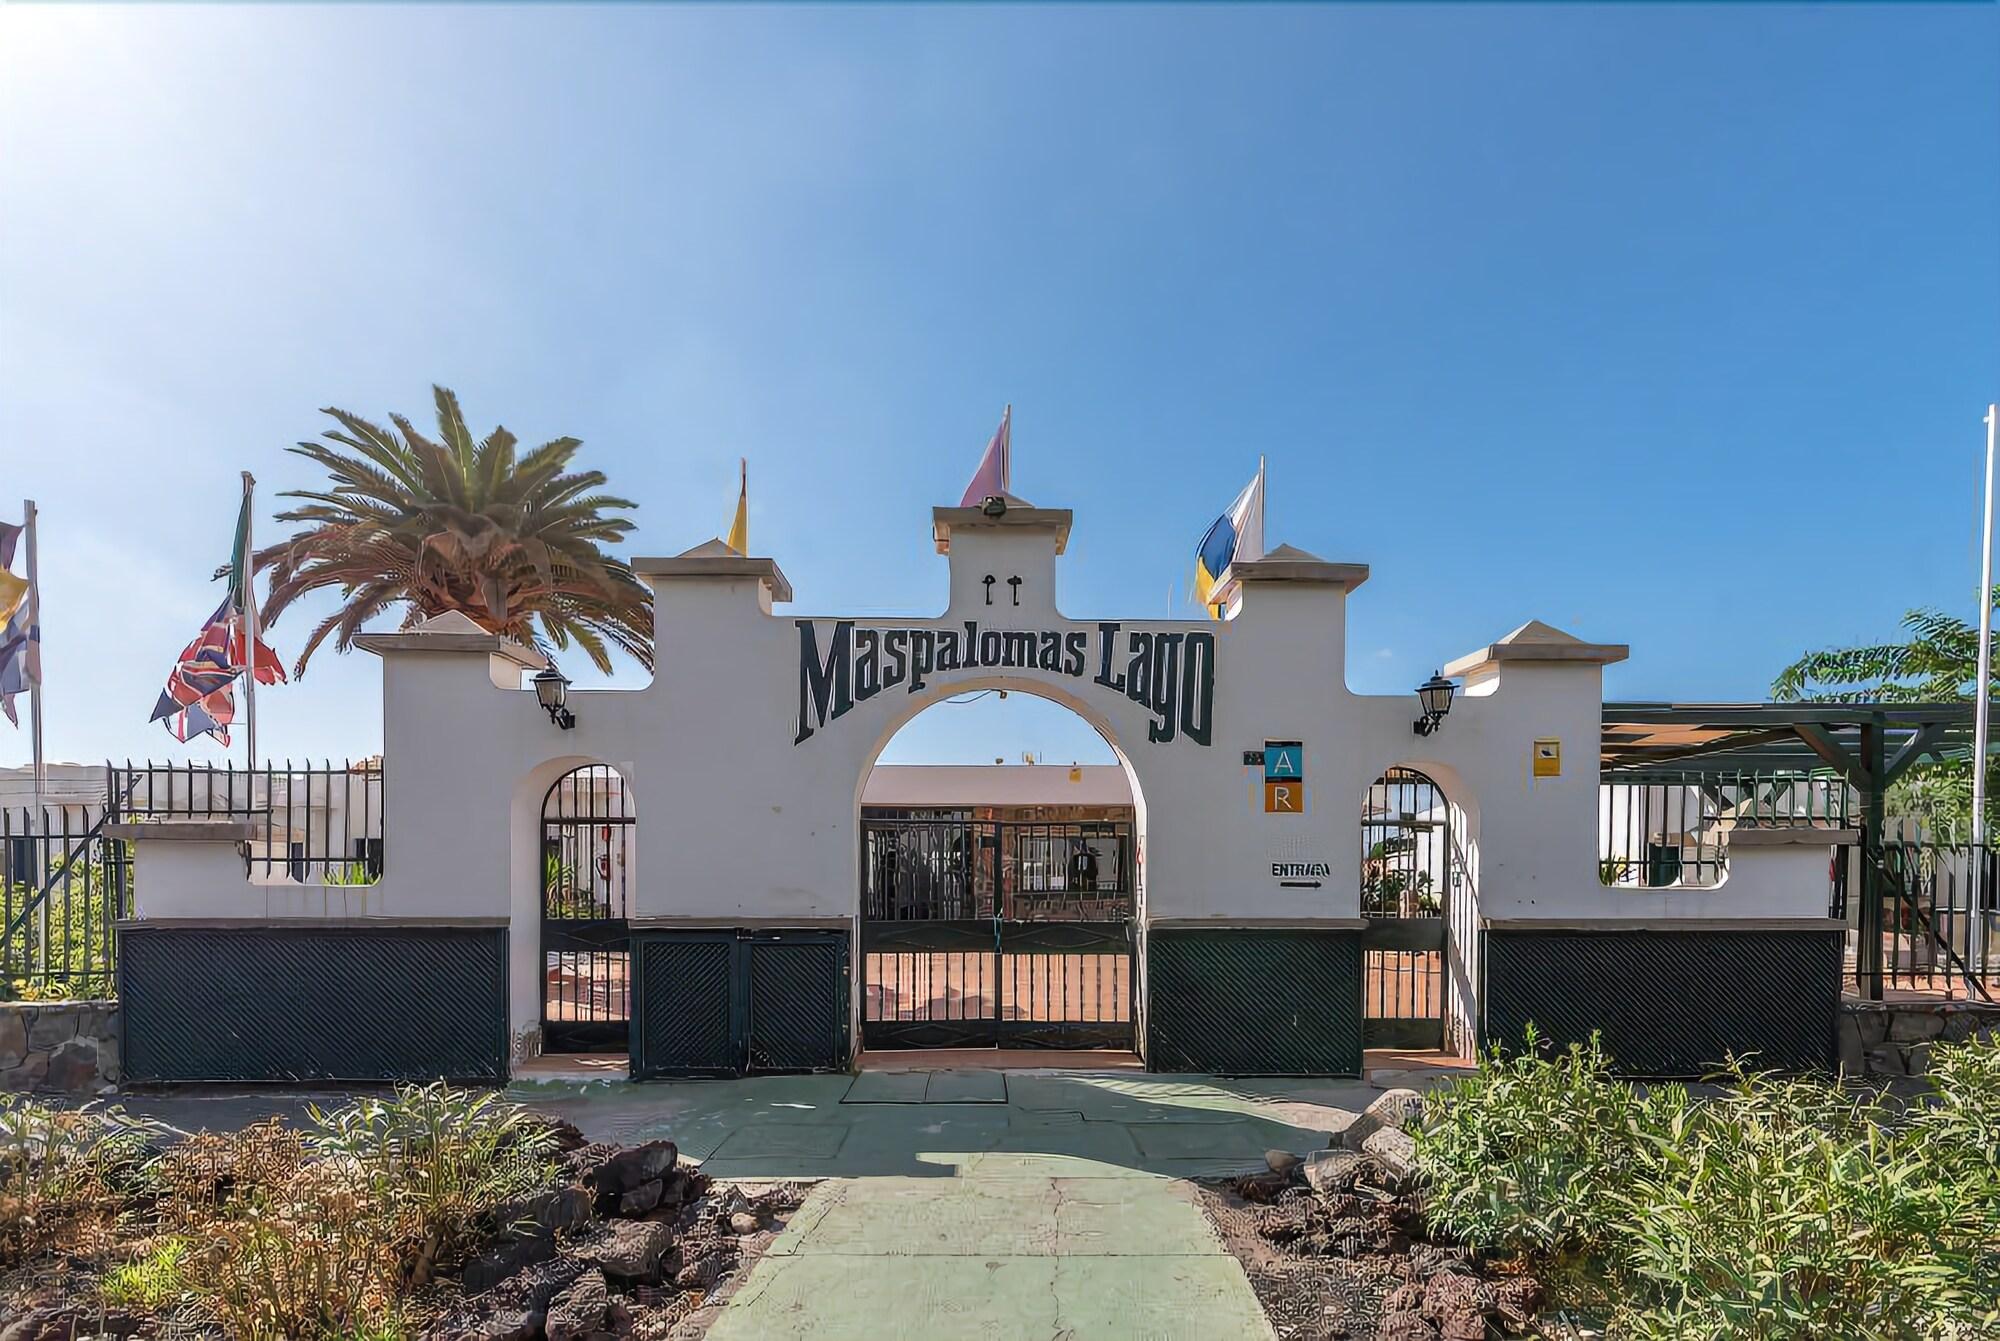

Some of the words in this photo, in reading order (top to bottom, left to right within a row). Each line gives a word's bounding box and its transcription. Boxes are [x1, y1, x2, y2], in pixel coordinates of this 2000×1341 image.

[794, 620, 1086, 746] Maspalomas
[1094, 622, 1215, 746] Lago
[1274, 750, 1294, 773] A
[1274, 786, 1292, 810] R
